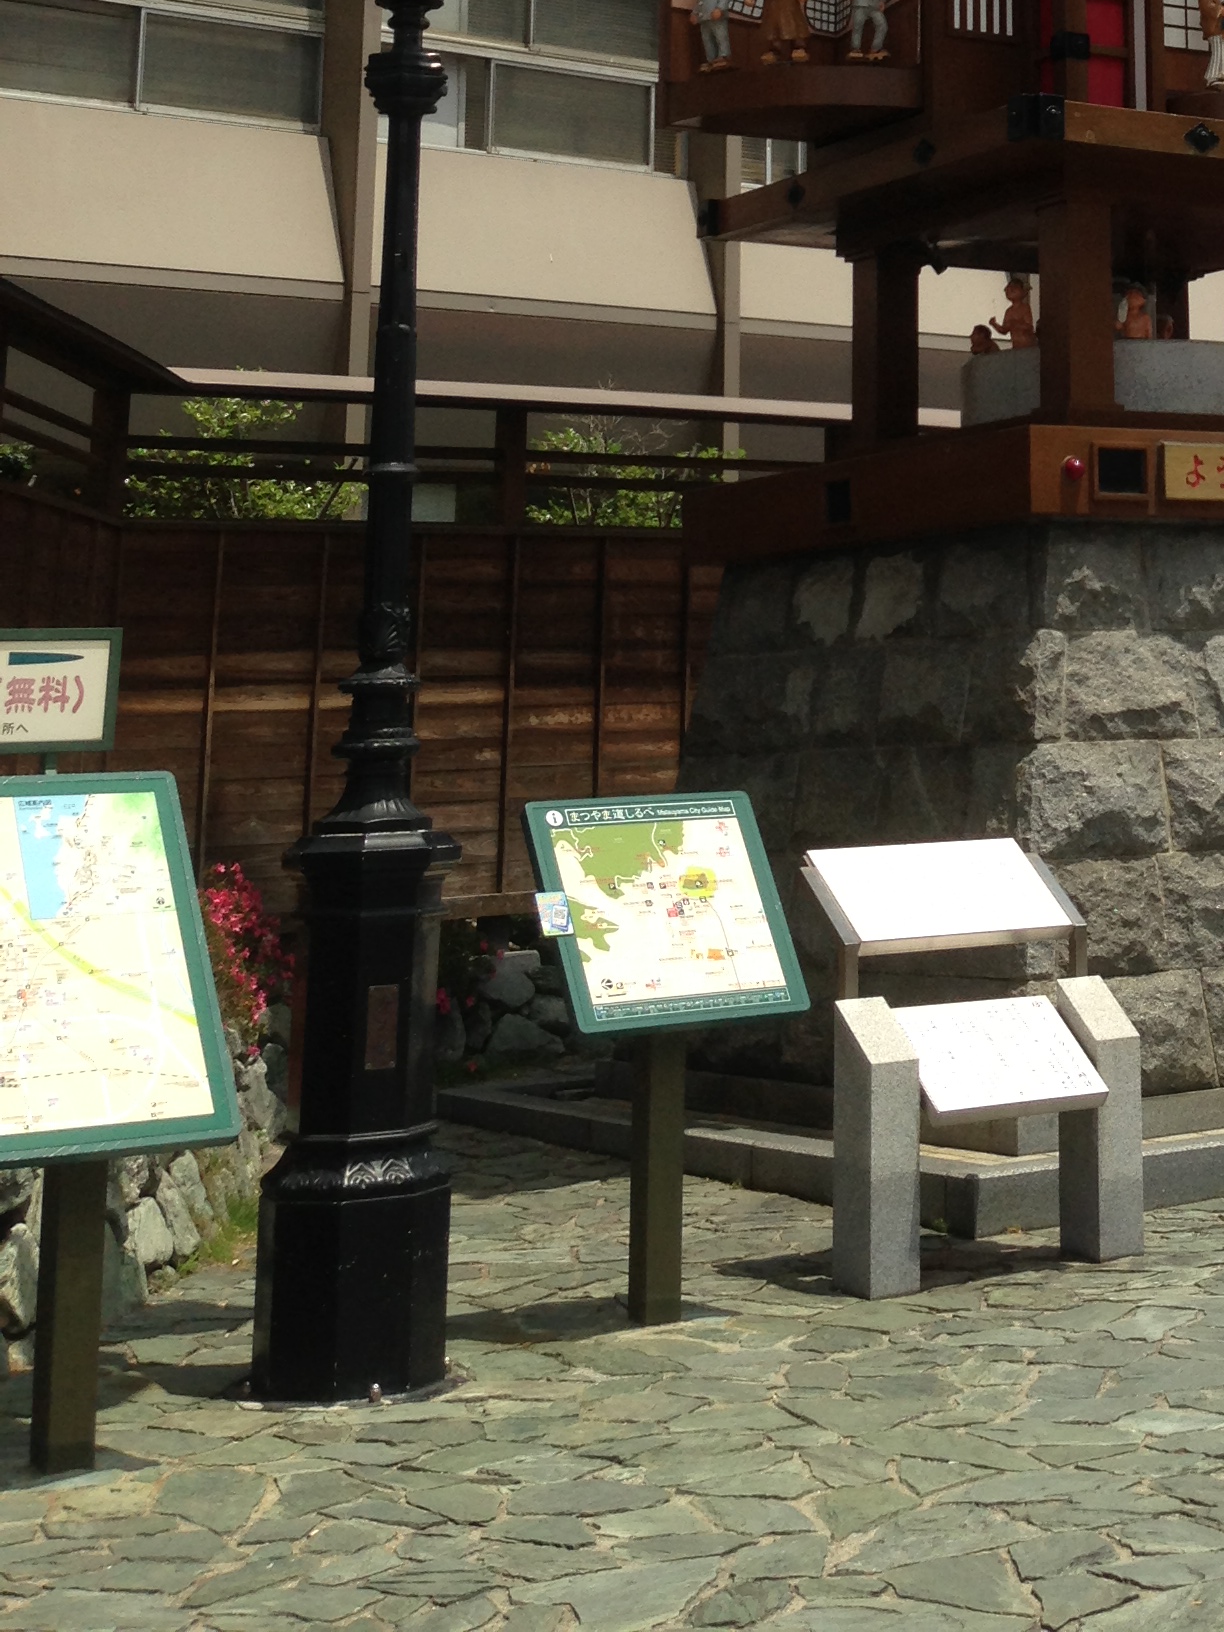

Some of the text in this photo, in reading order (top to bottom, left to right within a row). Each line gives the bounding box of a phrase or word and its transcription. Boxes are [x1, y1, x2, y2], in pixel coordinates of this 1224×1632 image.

[0, 675, 85, 714] 無料)
[569, 807, 655, 822] まつやま道しるべ
